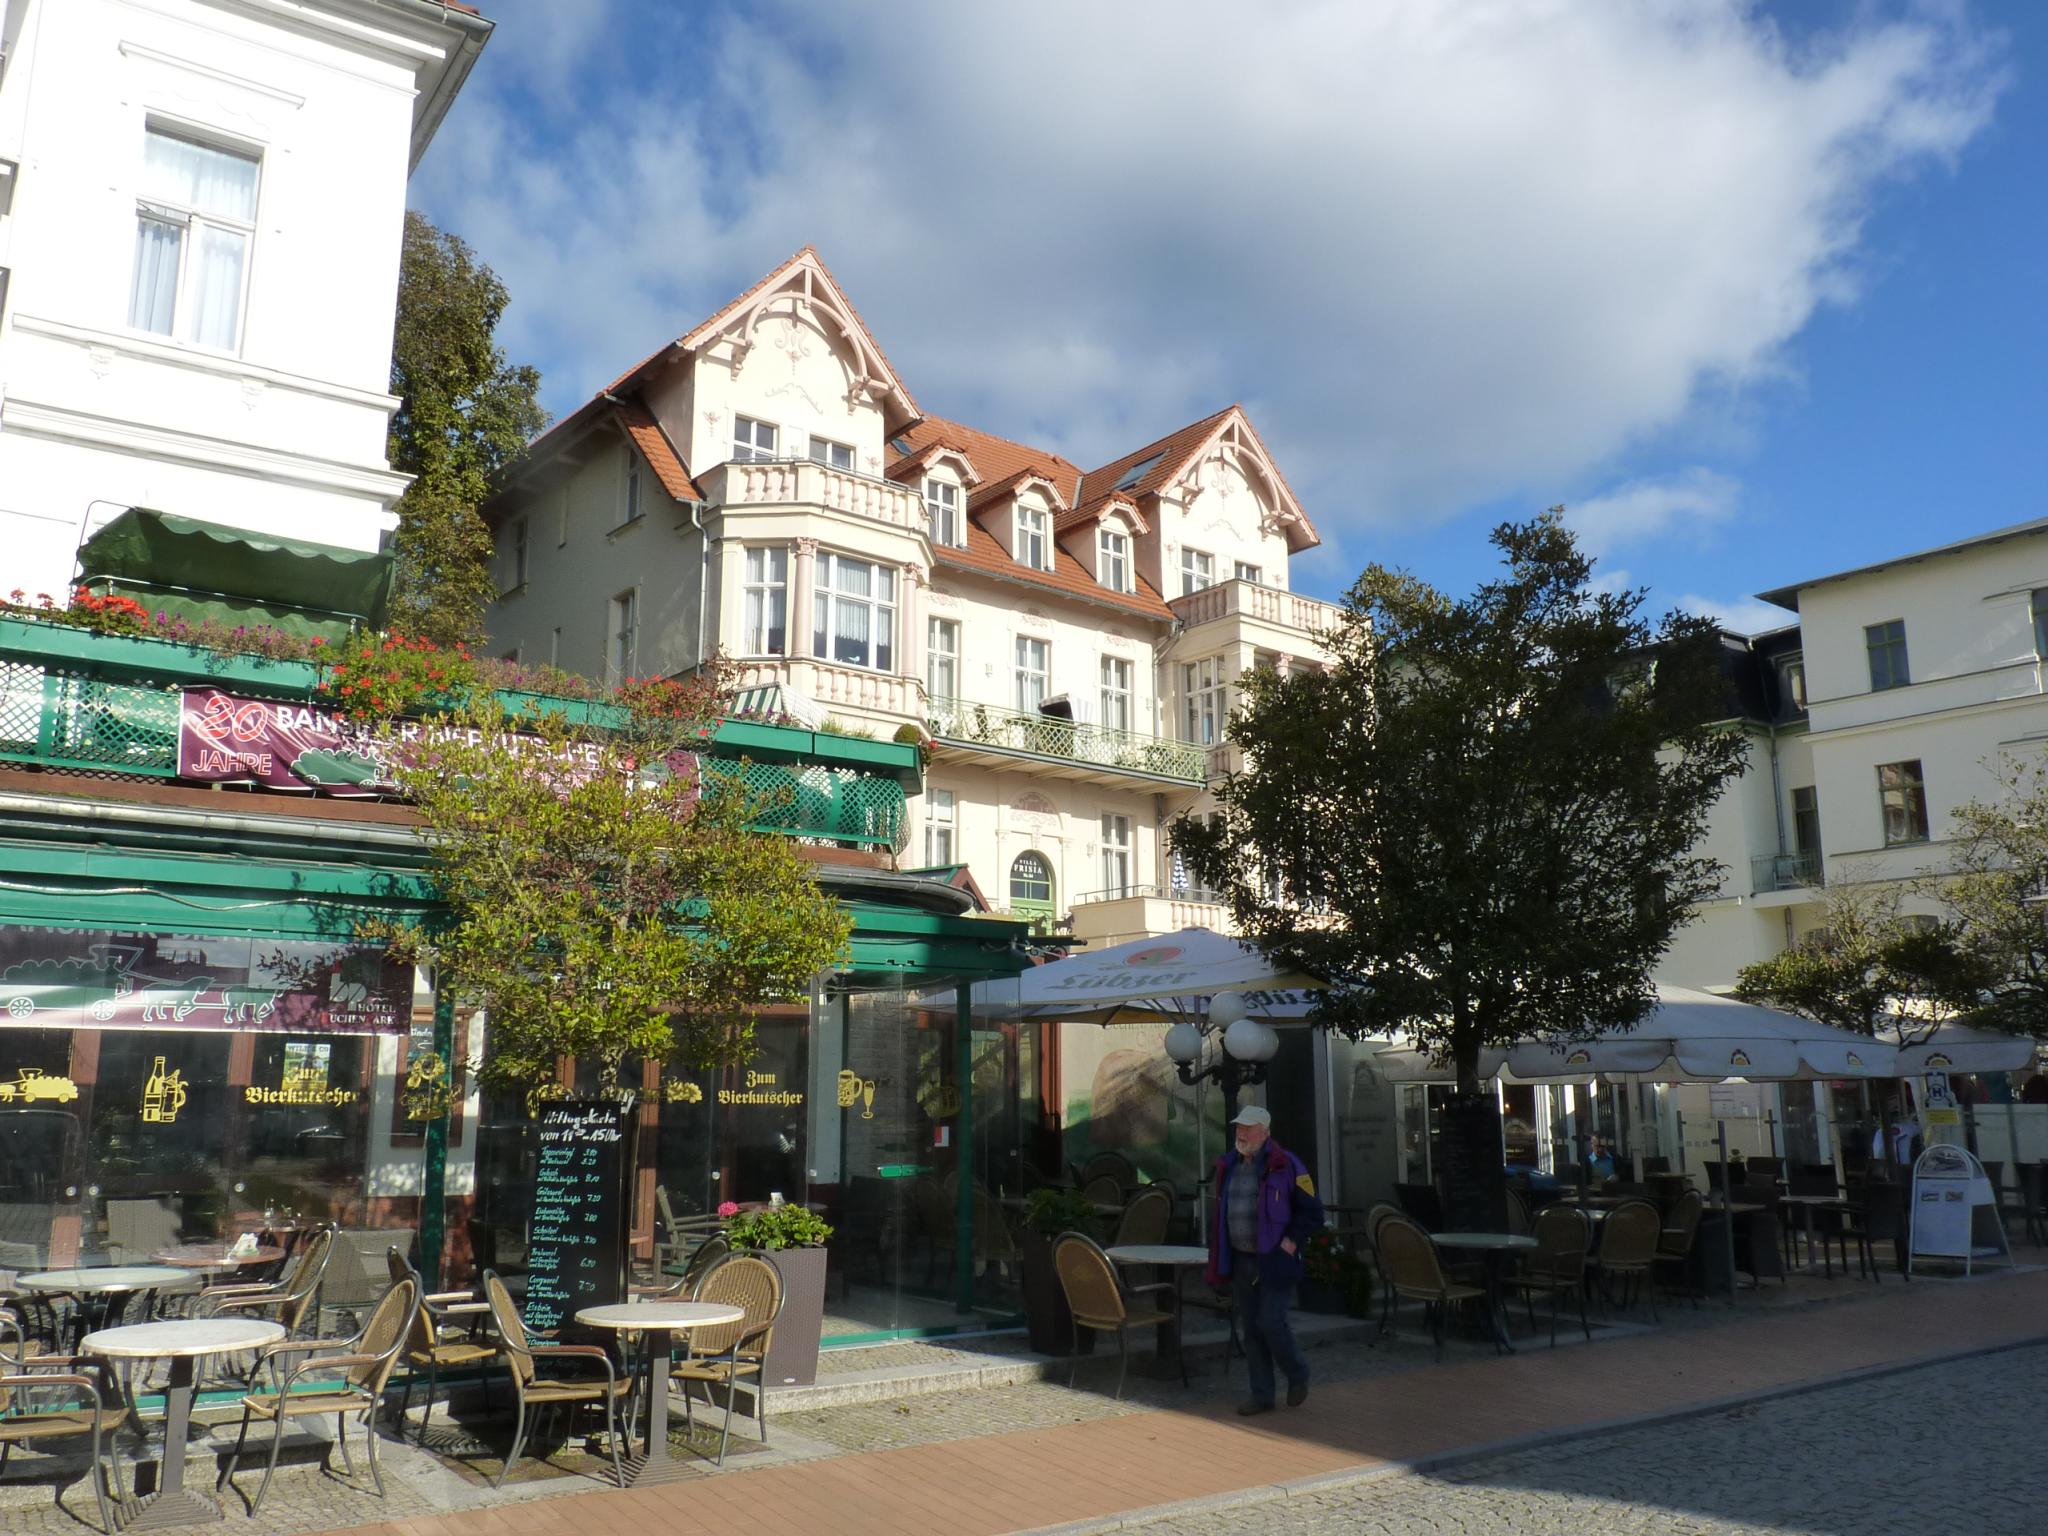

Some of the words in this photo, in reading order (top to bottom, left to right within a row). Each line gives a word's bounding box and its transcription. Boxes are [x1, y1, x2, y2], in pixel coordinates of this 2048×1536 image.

[197, 695, 269, 742] 20
[192, 750, 272, 775] JAHRE
[1014, 864, 1042, 874] FRISIA
[1045, 970, 1197, 990] Lübzer
[358, 1003, 396, 1013] HOTEL
[746, 1070, 776, 1088] Zum
[718, 1090, 803, 1107] Bierkutscher
